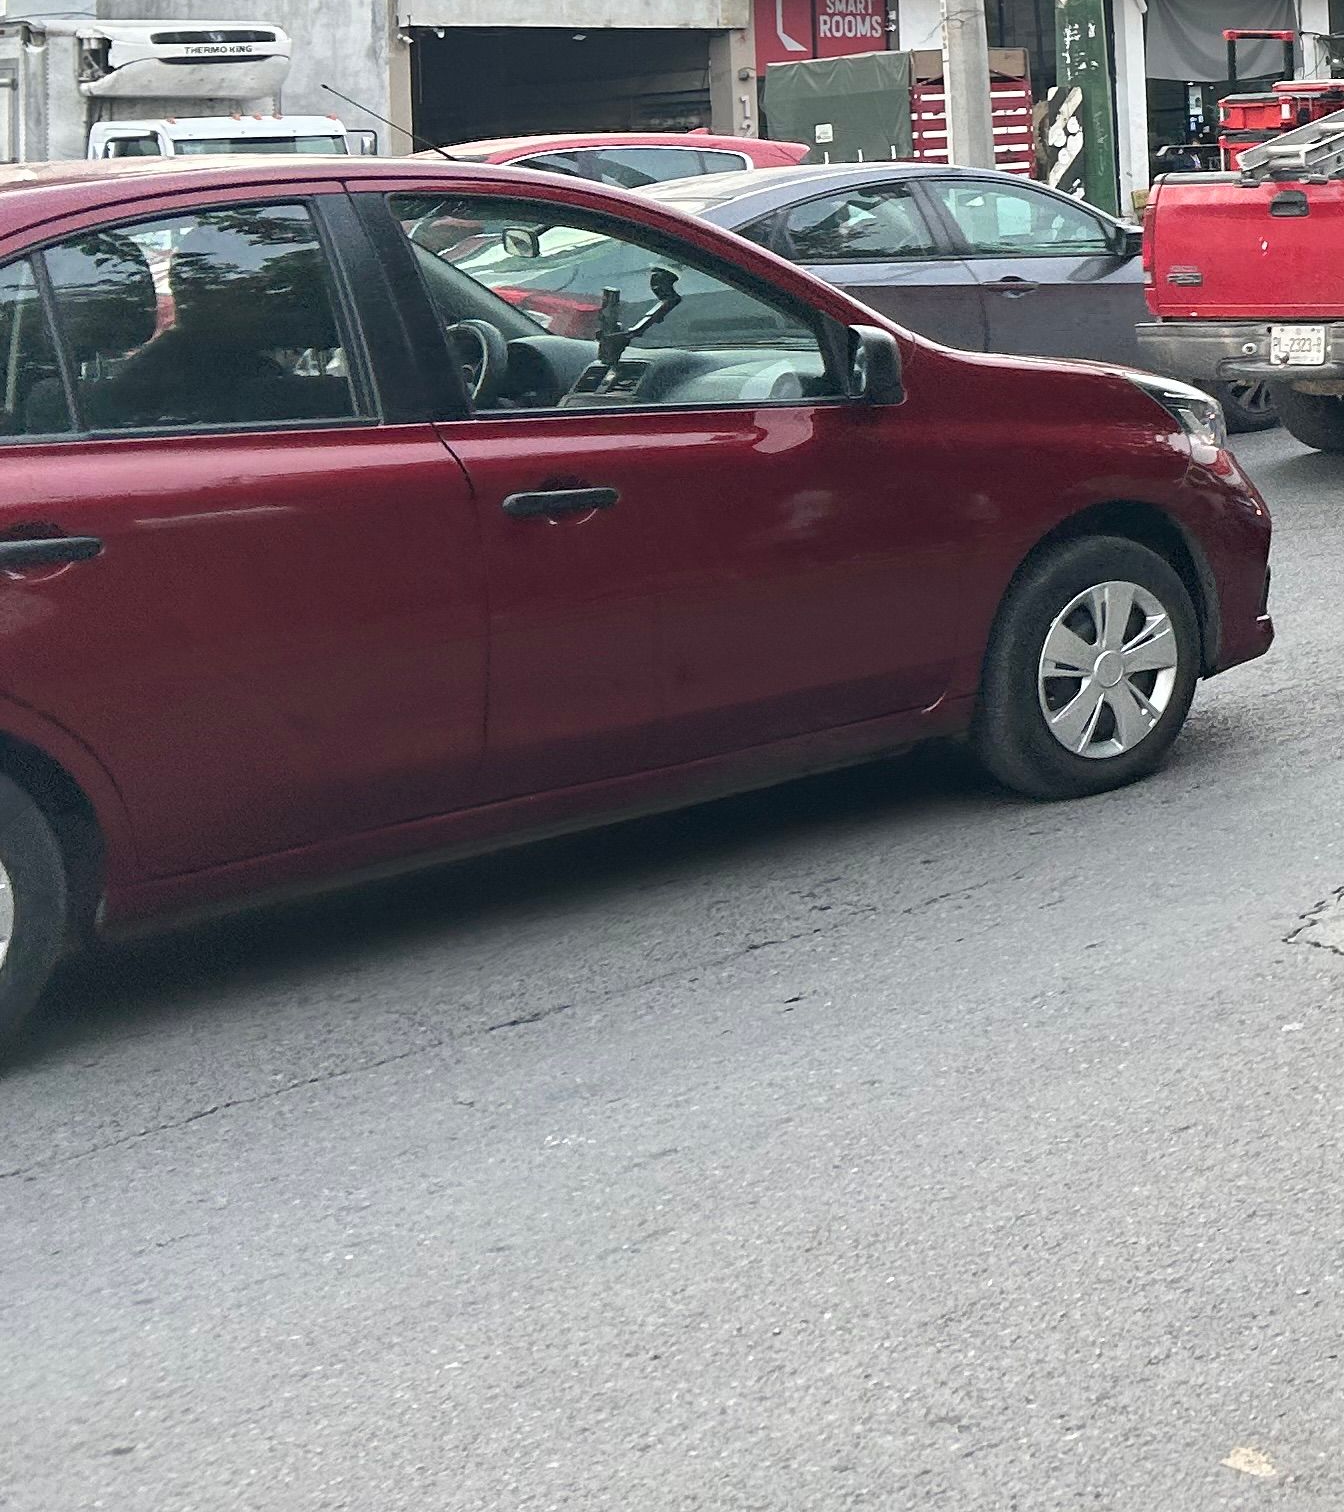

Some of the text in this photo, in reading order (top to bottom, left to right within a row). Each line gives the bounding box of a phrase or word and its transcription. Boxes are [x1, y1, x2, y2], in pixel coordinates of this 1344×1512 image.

[820, 15, 882, 38] ROOMS
[184, 45, 253, 55] THERMO KING
